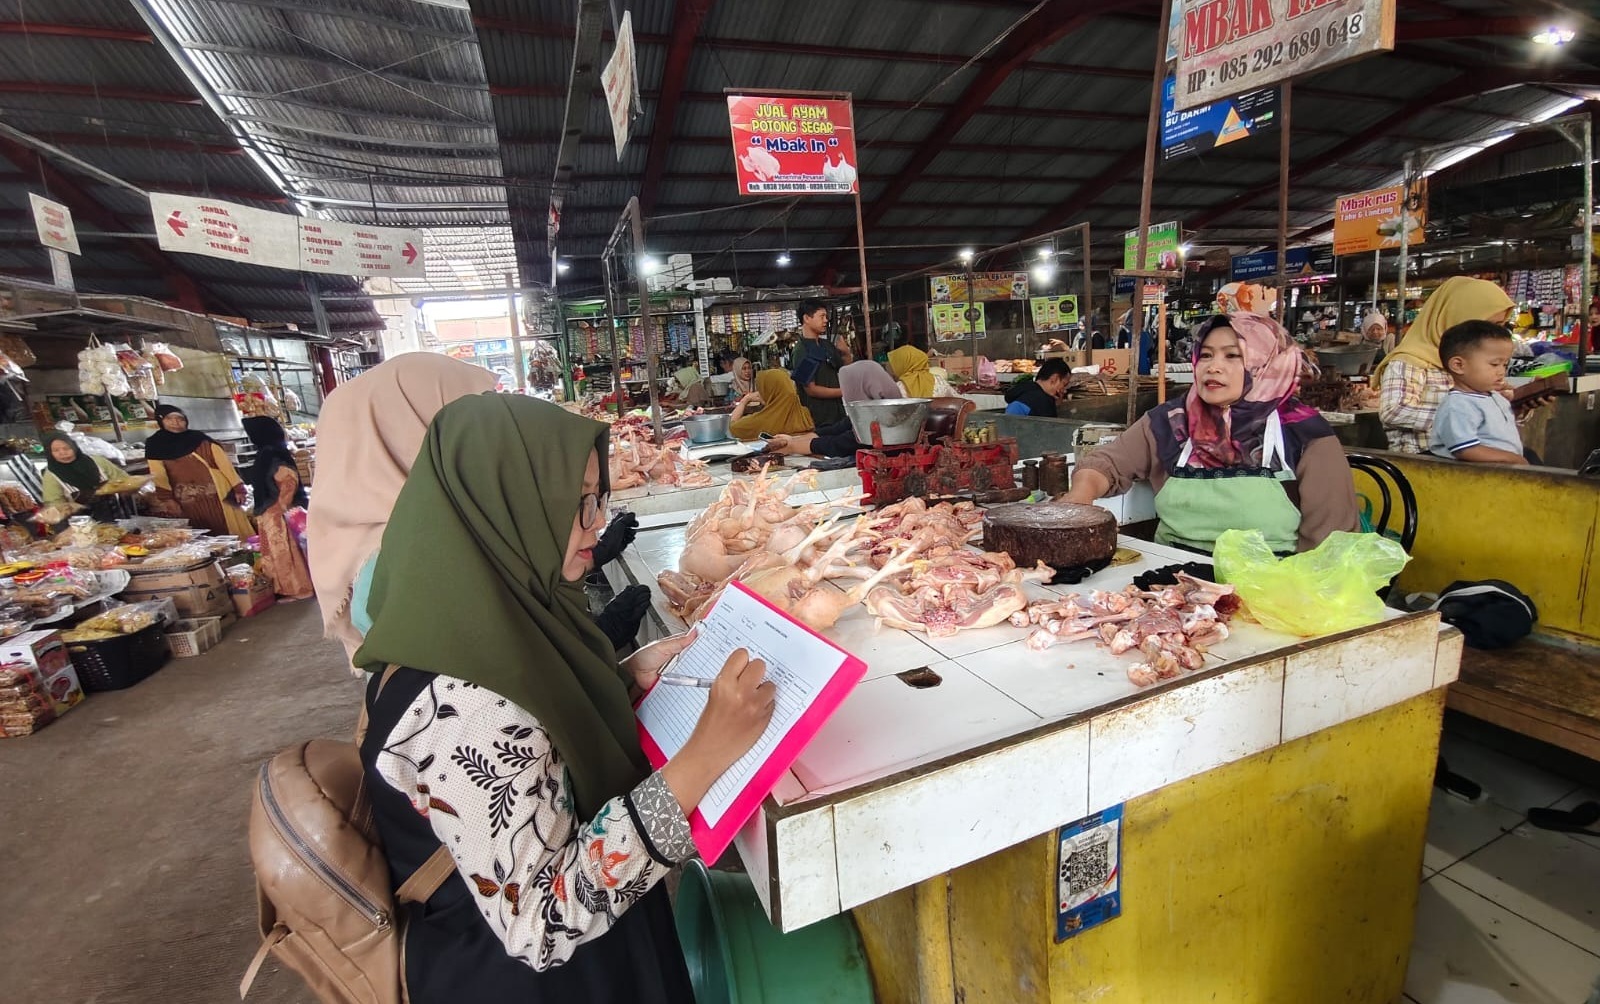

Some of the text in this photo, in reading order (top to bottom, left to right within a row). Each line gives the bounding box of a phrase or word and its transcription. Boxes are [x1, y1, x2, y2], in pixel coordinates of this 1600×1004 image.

[1187, 72, 1206, 94] HP
[1219, 53, 1247, 83] 085
[1252, 41, 1283, 73] 292
[1288, 27, 1321, 61] 689
[1326, 14, 1362, 47] 648
[755, 104, 828, 119] JUAL AYAM
[751, 120, 834, 134] POTONG SEGAR
[1165, 115, 1178, 127] BU
[766, 137, 808, 152] Mbak
[811, 139, 826, 152] In
[1340, 191, 1397, 212] Mbak rus
[200, 205, 229, 217] SANDAL
[1340, 212, 1357, 222] Tahu
[206, 228, 250, 243] GRABAAN
[210, 241, 249, 255] KEMBANG
